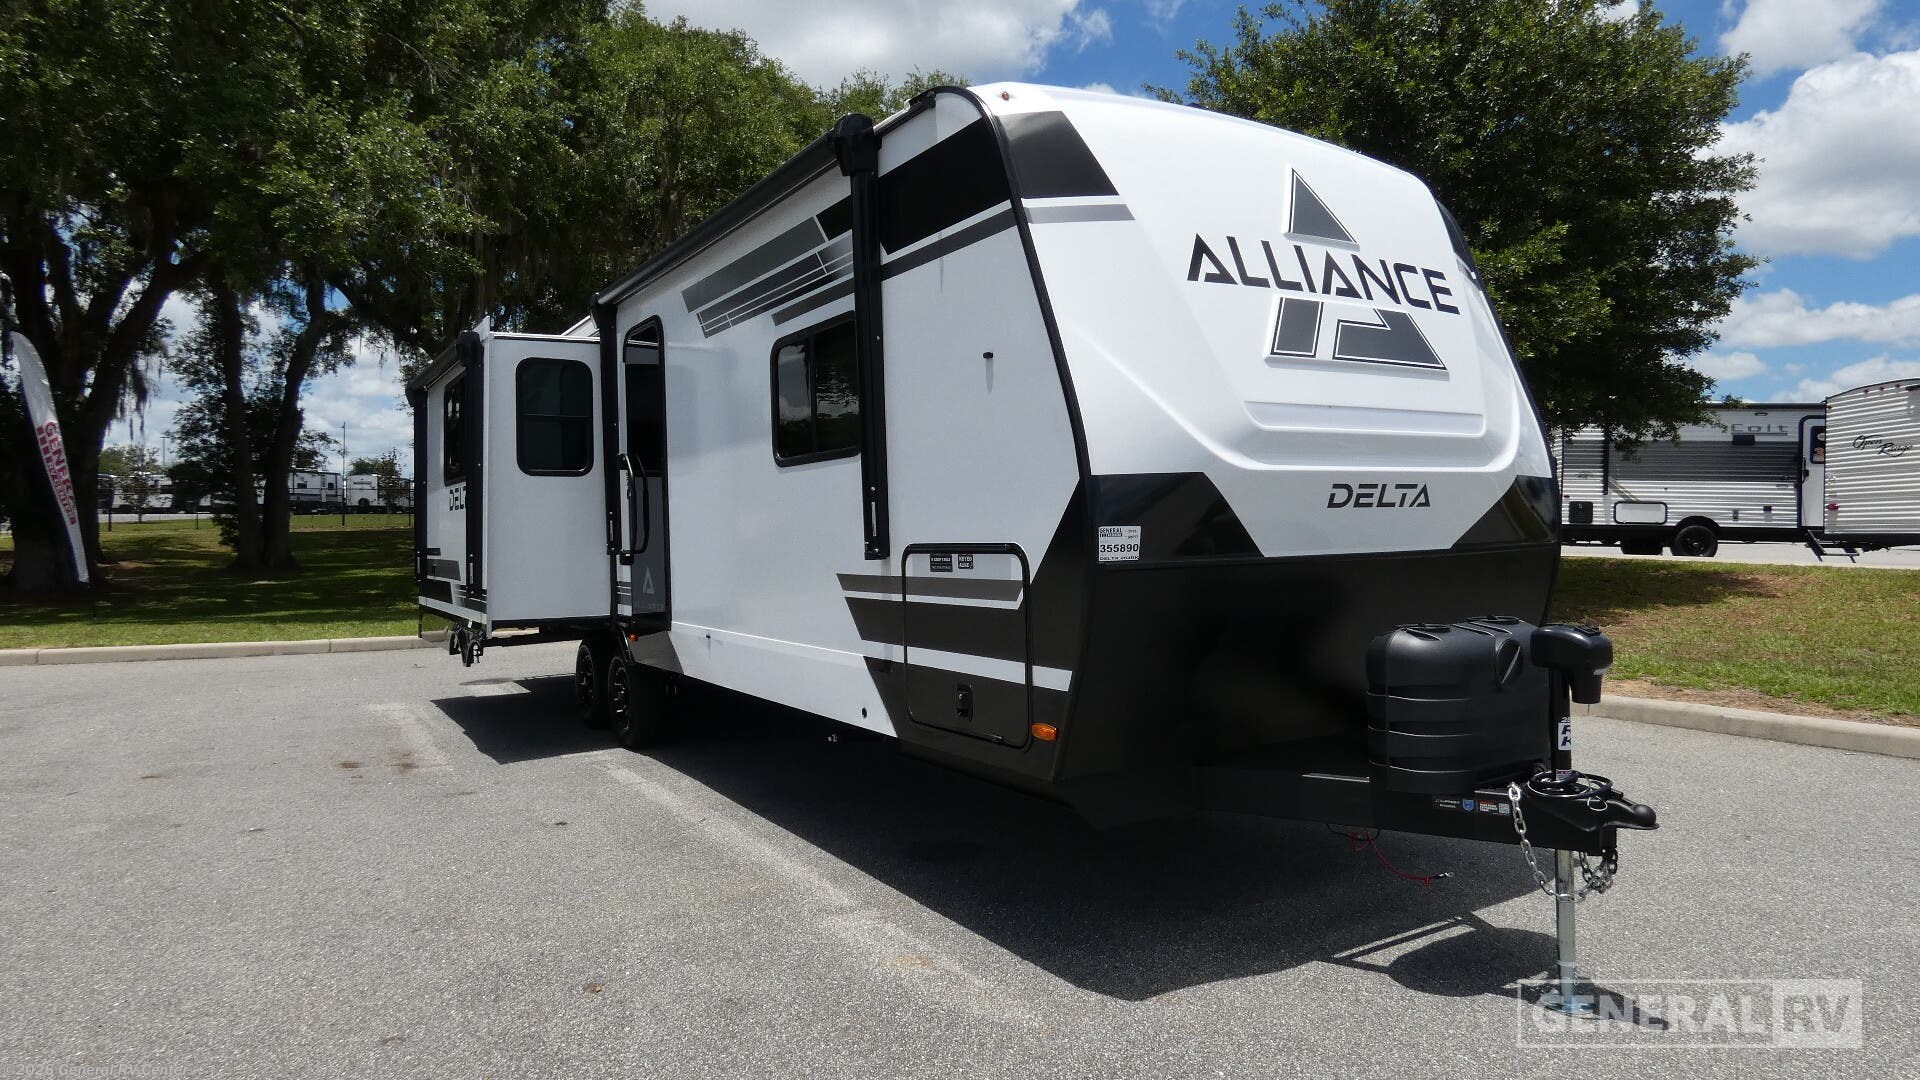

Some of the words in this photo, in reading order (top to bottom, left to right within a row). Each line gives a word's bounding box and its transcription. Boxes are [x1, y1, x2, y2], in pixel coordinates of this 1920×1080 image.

[1187, 233, 1461, 315] ALLIANCE
[1731, 423, 1789, 433] Colt
[1853, 434, 1884, 450] Open
[1877, 442, 1913, 457] Range
[1327, 482, 1431, 508] DELTA
[1100, 544, 1139, 553] 355890
